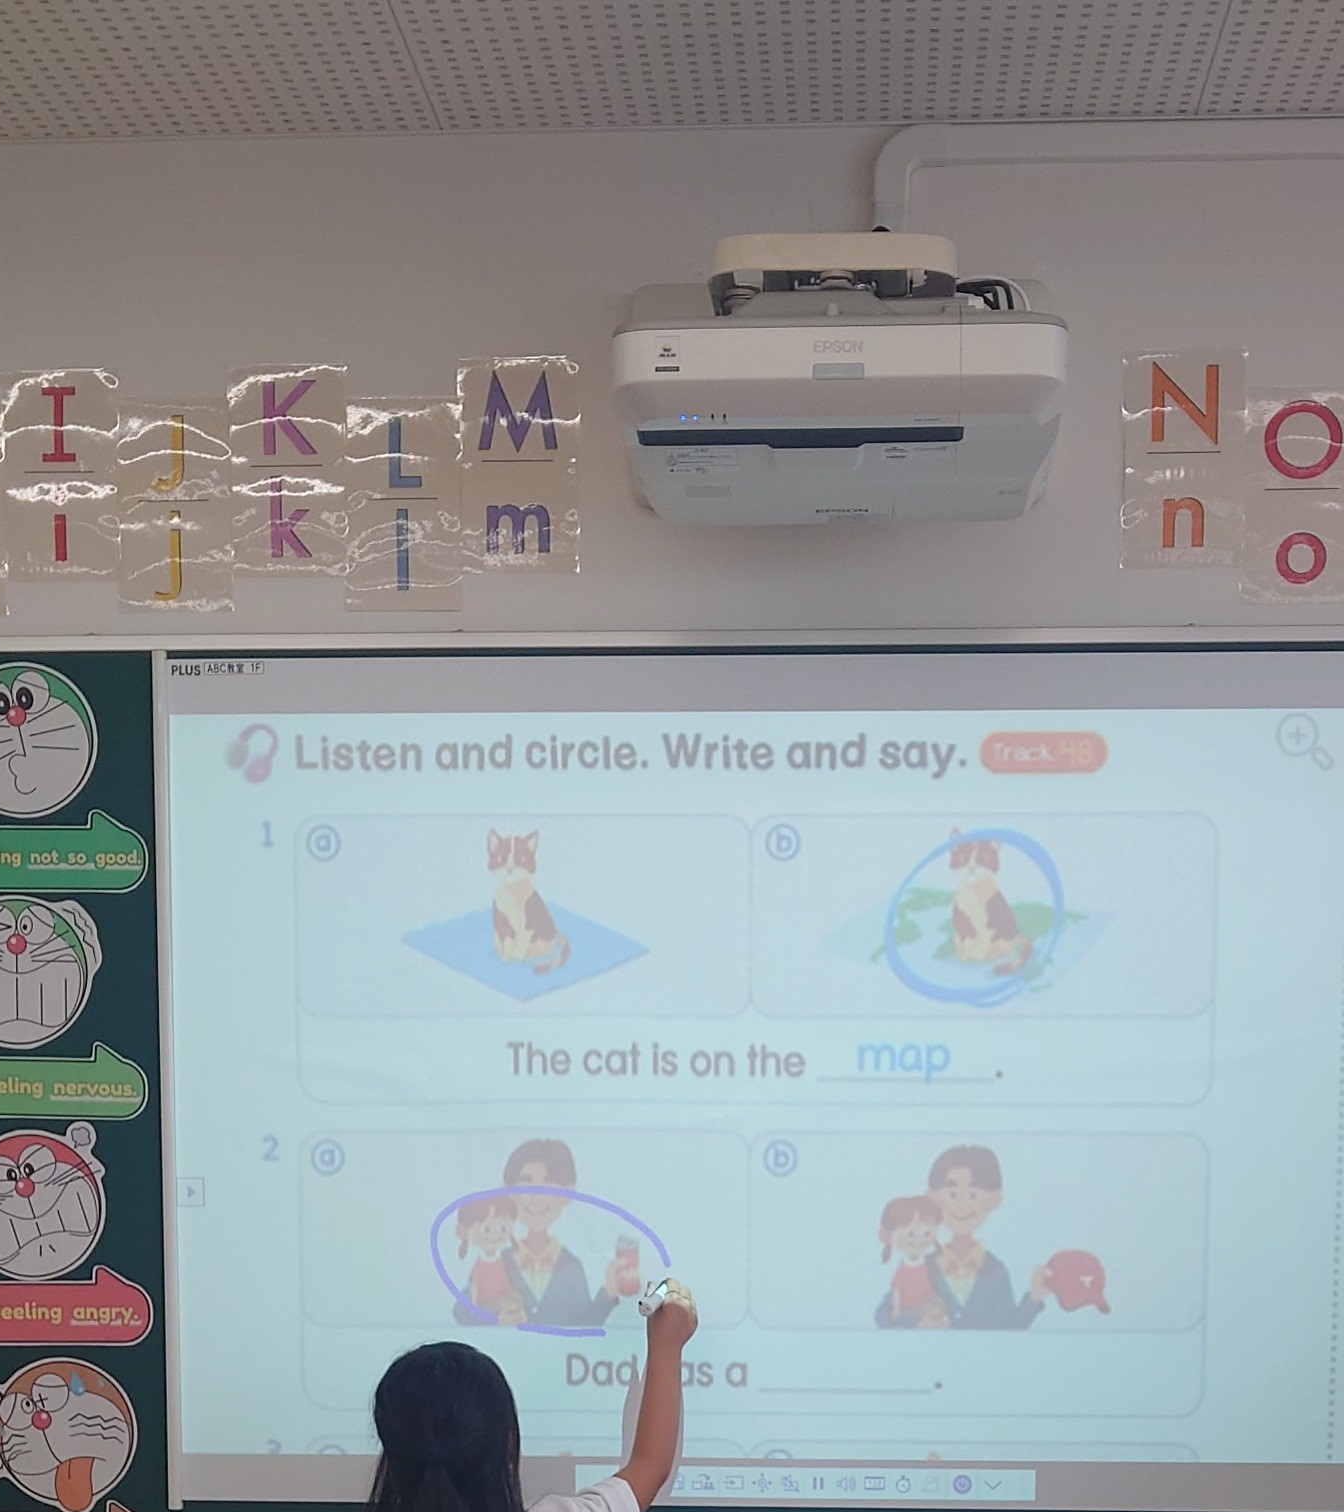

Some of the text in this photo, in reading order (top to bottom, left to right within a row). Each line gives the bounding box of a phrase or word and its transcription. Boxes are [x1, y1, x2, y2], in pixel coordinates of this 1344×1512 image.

[813, 340, 864, 354] EPSON
[41, 386, 76, 462] I
[262, 380, 317, 455] K
[478, 370, 558, 452] M
[1152, 361, 1219, 445] N
[151, 414, 184, 491] J
[389, 418, 421, 488] L
[1264, 400, 1343, 480] O
[486, 503, 550, 554] m
[1162, 497, 1204, 547] n
[171, 664, 201, 676] PLUS
[295, 733, 968, 779] Listen and circle. Write and say.
[994, 739, 1093, 765] Track 48
[261, 821, 274, 847] 1
[29, 849, 60, 866] not
[67, 853, 87, 866] so
[95, 848, 142, 871] good.
[508, 1040, 951, 1084] The cat is on the map
[54, 1081, 138, 1098] nervous.
[261, 1135, 279, 1162] 2
[72, 1304, 140, 1326] angry.
[566, 1353, 748, 1388] Dad a
